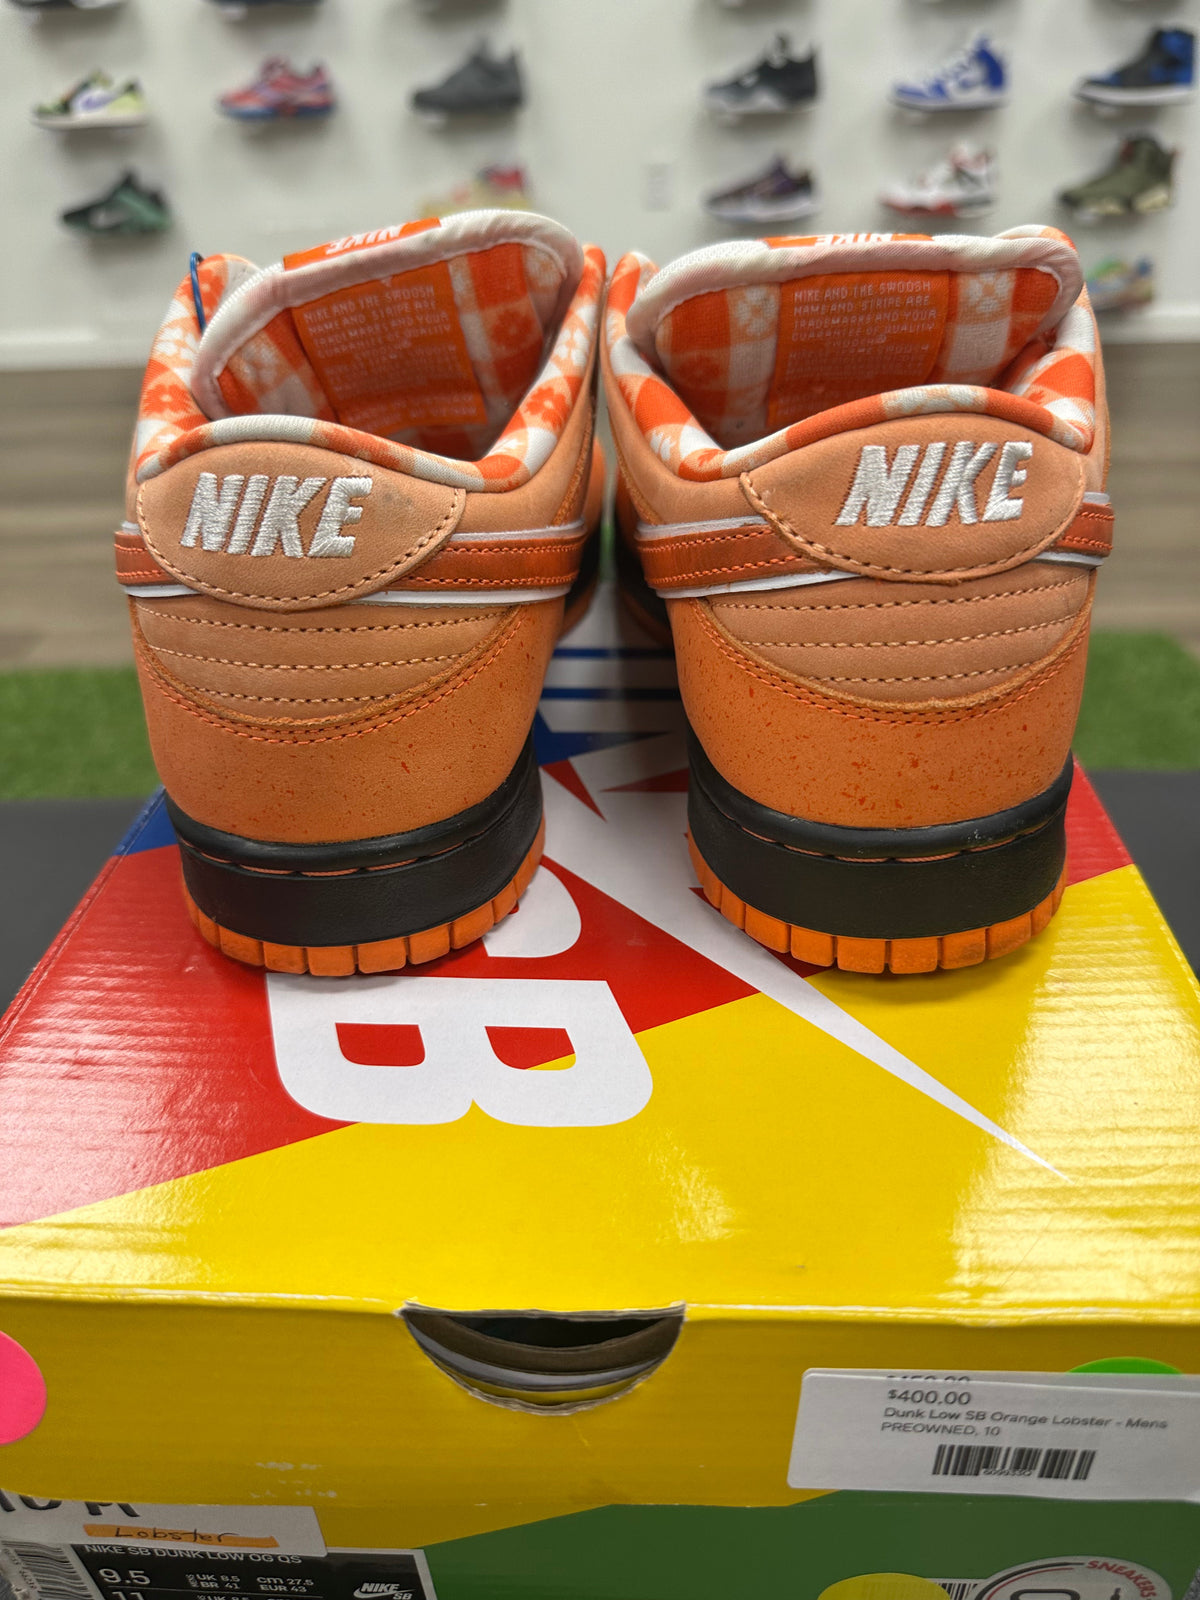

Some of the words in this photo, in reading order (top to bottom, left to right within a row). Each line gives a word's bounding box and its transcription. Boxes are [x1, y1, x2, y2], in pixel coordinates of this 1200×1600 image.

[825, 286, 848, 300] AND
[880, 281, 931, 294] SWOOSH
[303, 307, 330, 323] NIKE
[333, 300, 355, 315] AND
[385, 286, 435, 302] SWOOSH
[830, 302, 854, 313] AND
[906, 295, 930, 306] ARE
[343, 313, 366, 327] AND
[834, 440, 1033, 528] NIKE
[180, 472, 373, 558] NIKE
[887, 1389, 972, 1405] $400.00
[884, 1407, 926, 1419] Dunk
[929, 1409, 961, 1420] Low
[965, 1410, 986, 1421] SB
[991, 1411, 1048, 1426] Orange
[1052, 1415, 1112, 1427] Lobster
[1125, 1418, 1168, 1429] Mens
[881, 1422, 978, 1437] PREOWNED,
[985, 1426, 1002, 1437] 10
[115, 1528, 240, 1544] Lobster
[84, 1545, 125, 1556] NIKE
[128, 1547, 151, 1557] SB
[155, 1548, 204, 1559] DUNK
[207, 1551, 245, 1562] LOW
[249, 1553, 274, 1563] OG
[277, 1555, 302, 1564] QS
[99, 1568, 150, 1585] 9.5
[196, 1573, 216, 1581] UK
[286, 1578, 314, 1586] 27.5
[1086, 1560, 1157, 1598] SNEAKERS
[259, 1584, 288, 1592] EUR
[360, 1582, 400, 1592] NIKE
[393, 1592, 412, 1600] SB
